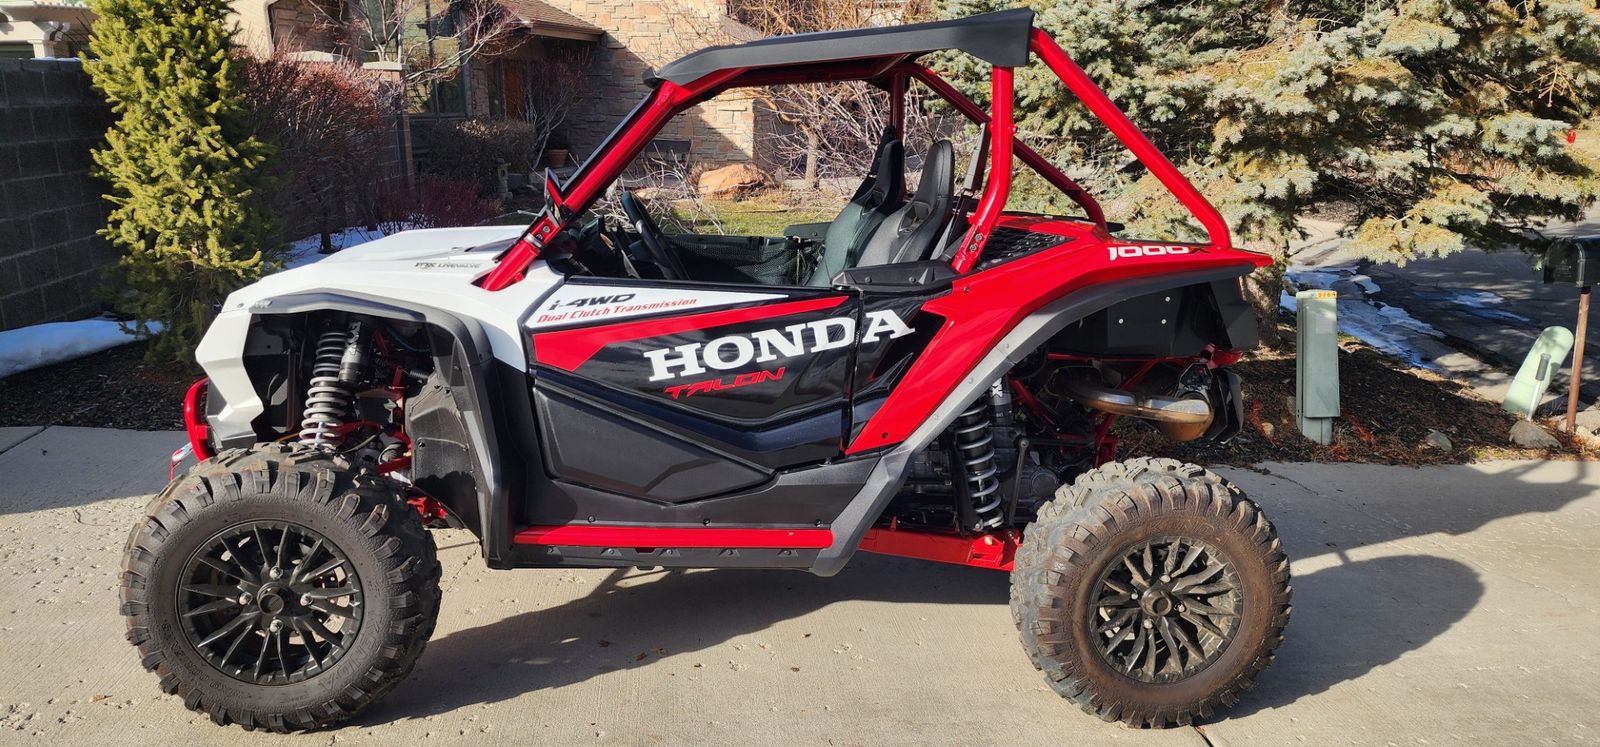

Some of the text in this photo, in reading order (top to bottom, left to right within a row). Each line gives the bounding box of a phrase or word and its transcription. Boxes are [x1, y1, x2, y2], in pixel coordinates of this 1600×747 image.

[537, 298, 698, 323] Dual Clutch Transmission
[549, 293, 636, 311] i-4WD
[643, 309, 916, 382] HONDA
[664, 367, 786, 399] TALON
